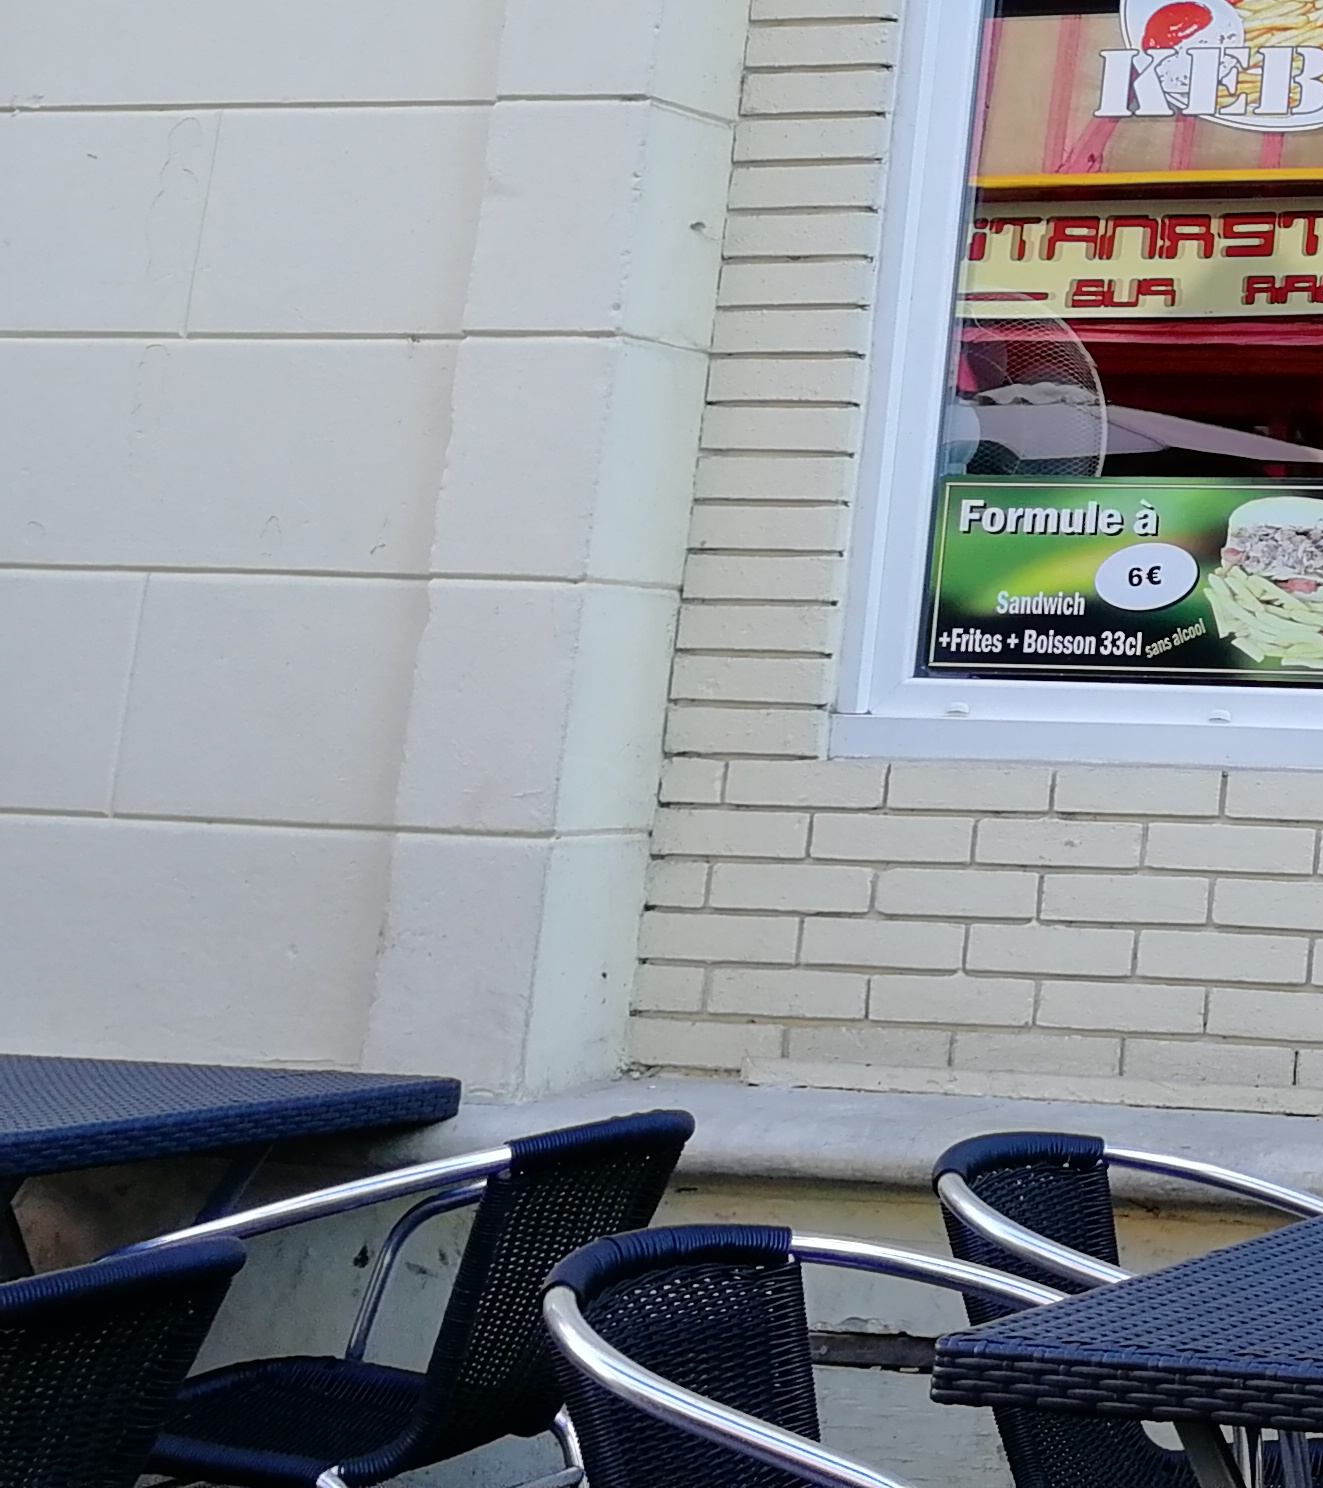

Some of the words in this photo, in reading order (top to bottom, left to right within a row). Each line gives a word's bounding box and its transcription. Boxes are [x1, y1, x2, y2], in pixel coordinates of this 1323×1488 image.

[958, 499, 1125, 535] Formule
[1133, 498, 1159, 536] à
[996, 590, 1086, 616] Sandwich
[1022, 628, 1097, 655] Boisson
[1100, 630, 1143, 656] 33cl
[1144, 636, 1172, 659] sans
[1172, 618, 1207, 648] alcool
